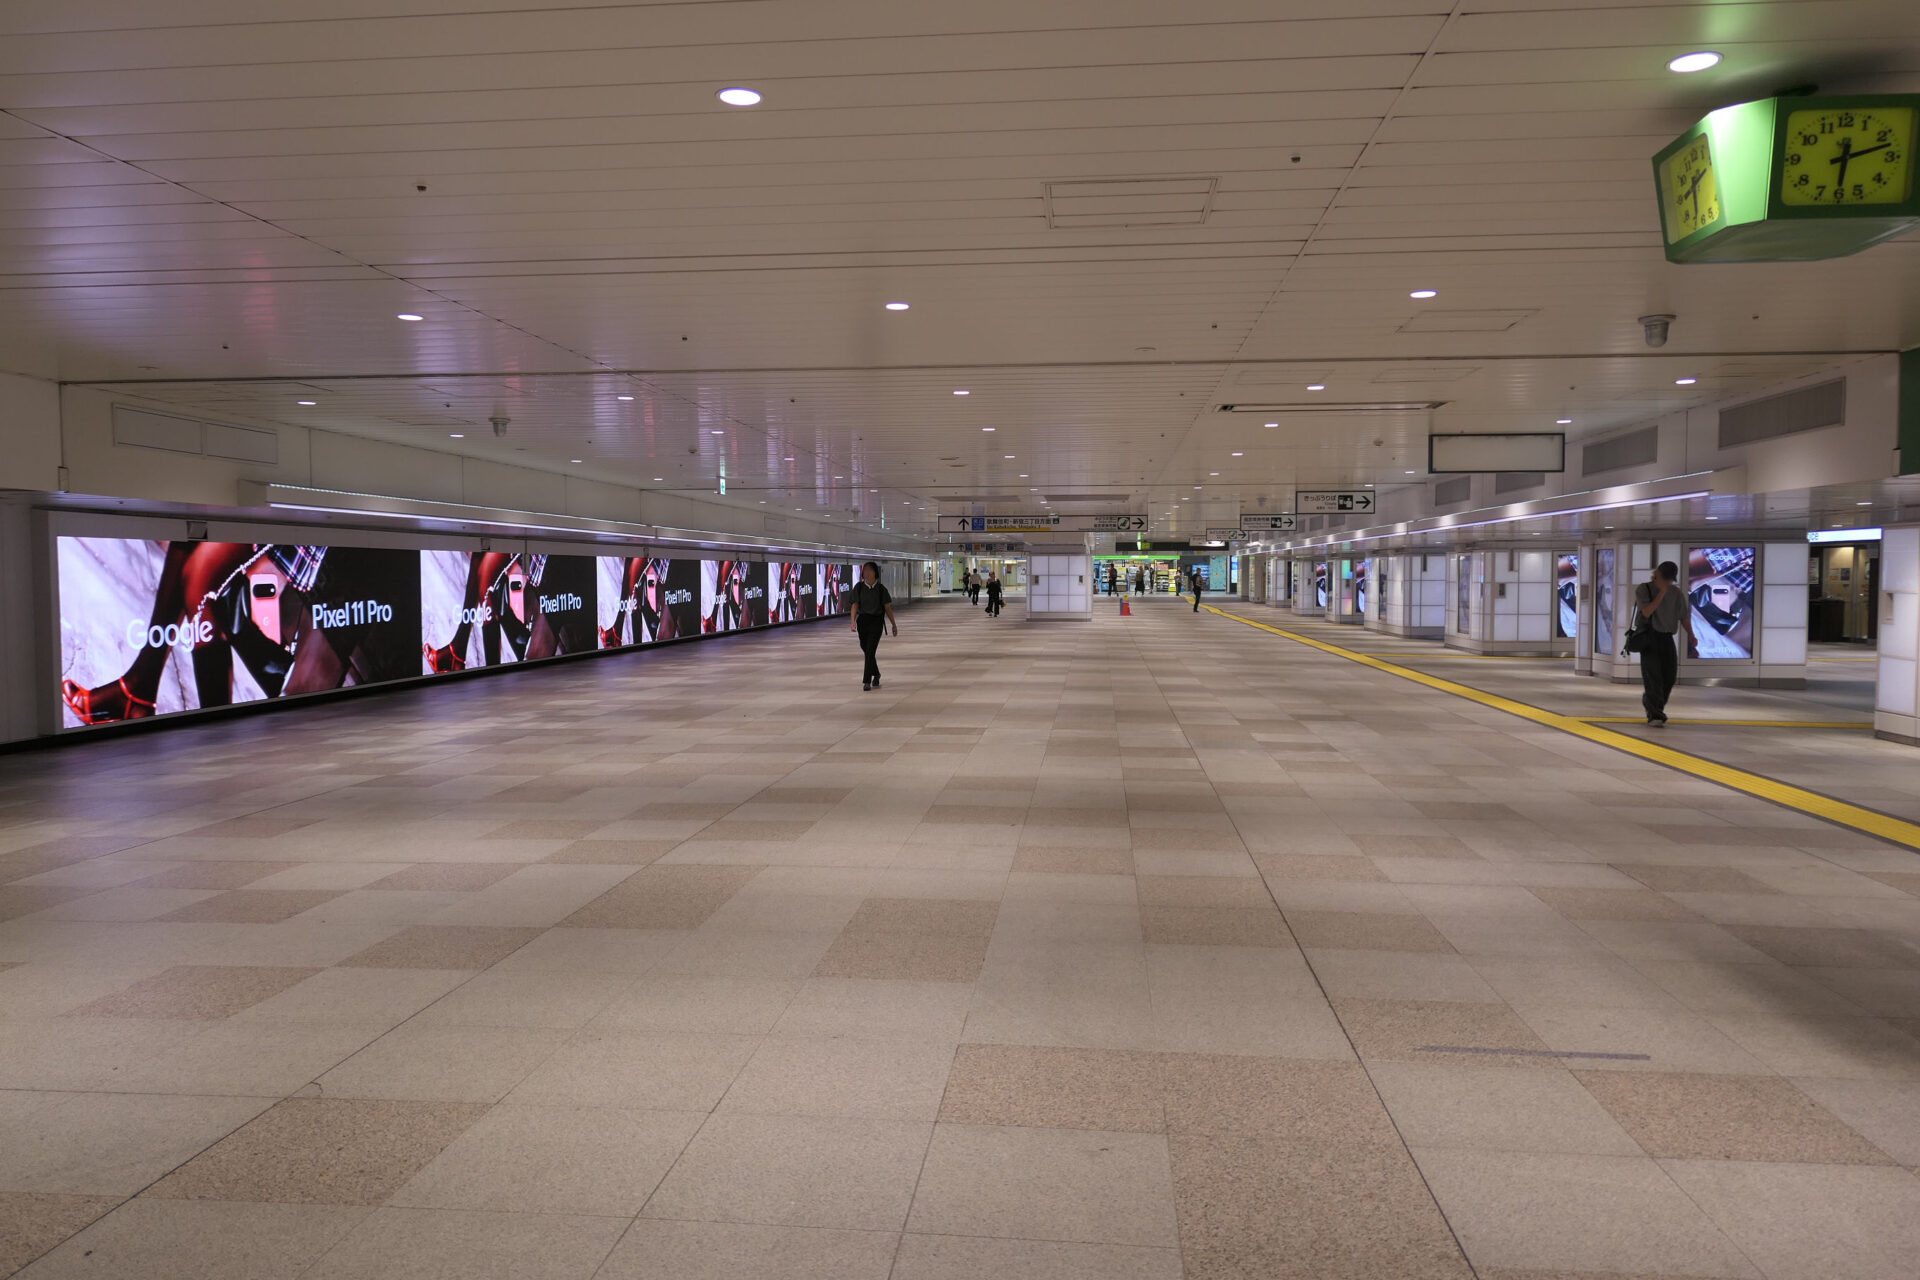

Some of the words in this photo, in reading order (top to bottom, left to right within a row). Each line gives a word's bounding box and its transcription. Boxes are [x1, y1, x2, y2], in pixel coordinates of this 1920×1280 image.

[1820, 121, 1834, 134] 11
[1838, 115, 1855, 128] 12
[1861, 119, 1869, 131] 1
[1801, 134, 1819, 146] 10
[1876, 130, 1889, 142] 2
[1690, 148, 1699, 162] 12
[1789, 153, 1802, 166] 9
[1884, 151, 1896, 163] 3
[1798, 174, 1809, 186] 8
[1872, 172, 1883, 184] 4
[1816, 185, 1827, 198] 7
[1833, 188, 1845, 200] 6
[1853, 184, 1864, 196] 5
[1677, 195, 1684, 206] 9
[540, 594, 560, 614] Pixel
[560, 594, 568, 611] 11
[568, 593, 582, 610] Pro
[312, 602, 350, 629] Pixel
[352, 601, 367, 625] 11
[368, 600, 393, 623] Pro
[452, 602, 492, 627] Google
[126, 612, 214, 652] Google
